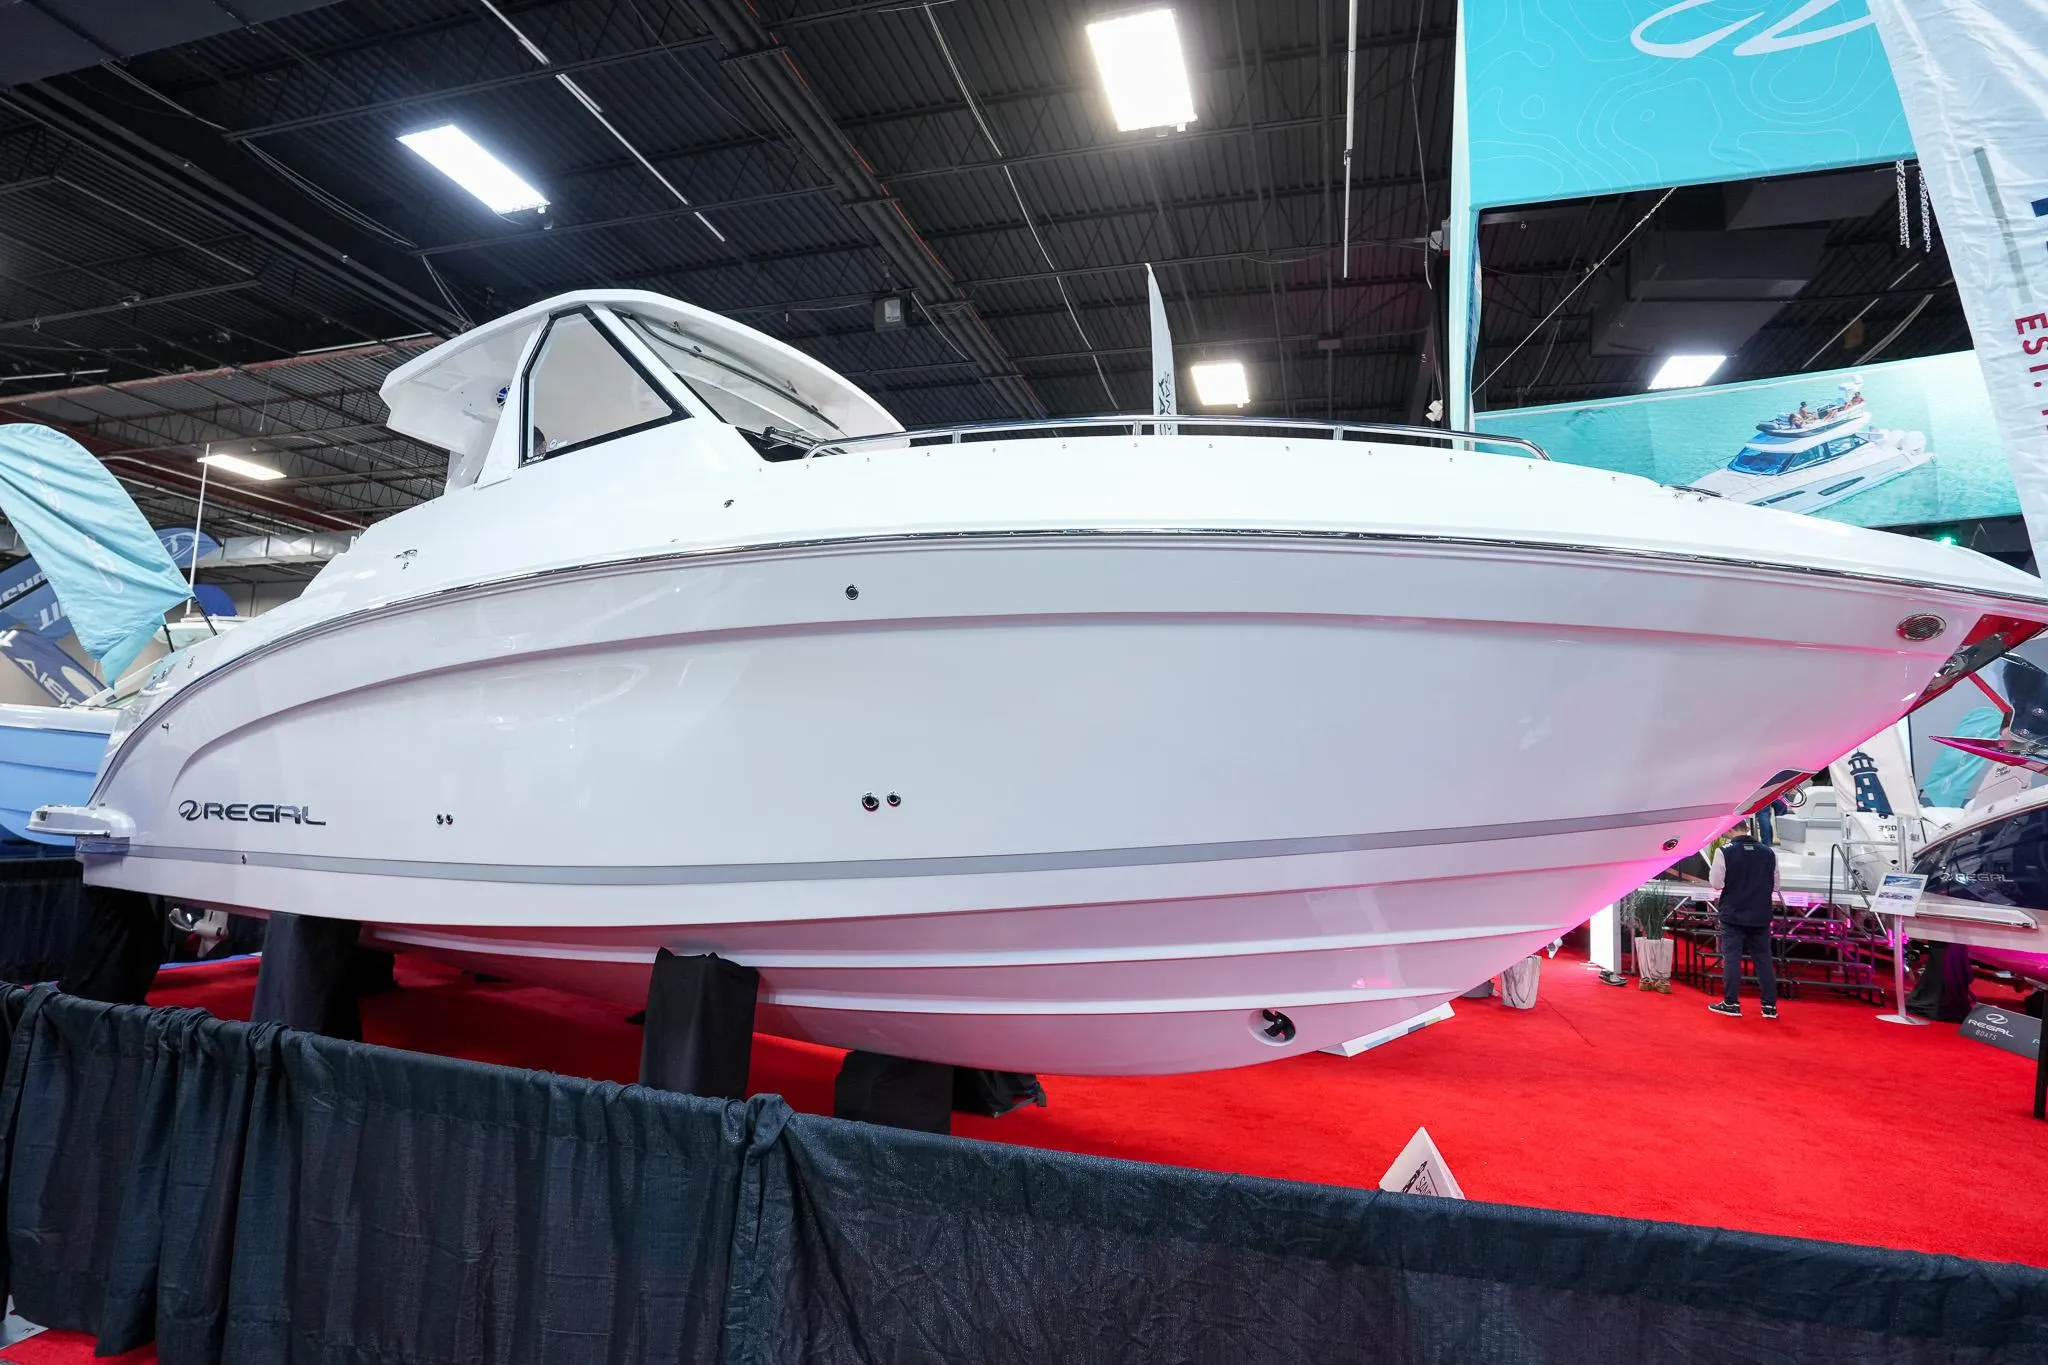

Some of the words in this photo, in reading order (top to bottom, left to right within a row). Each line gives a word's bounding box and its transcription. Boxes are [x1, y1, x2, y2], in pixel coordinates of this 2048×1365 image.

[203, 802, 327, 826] REGAL
[1955, 873, 2015, 883] REGAL
[1967, 1018, 2015, 1038] REGAL
[1975, 1029, 1998, 1041] BOATS
